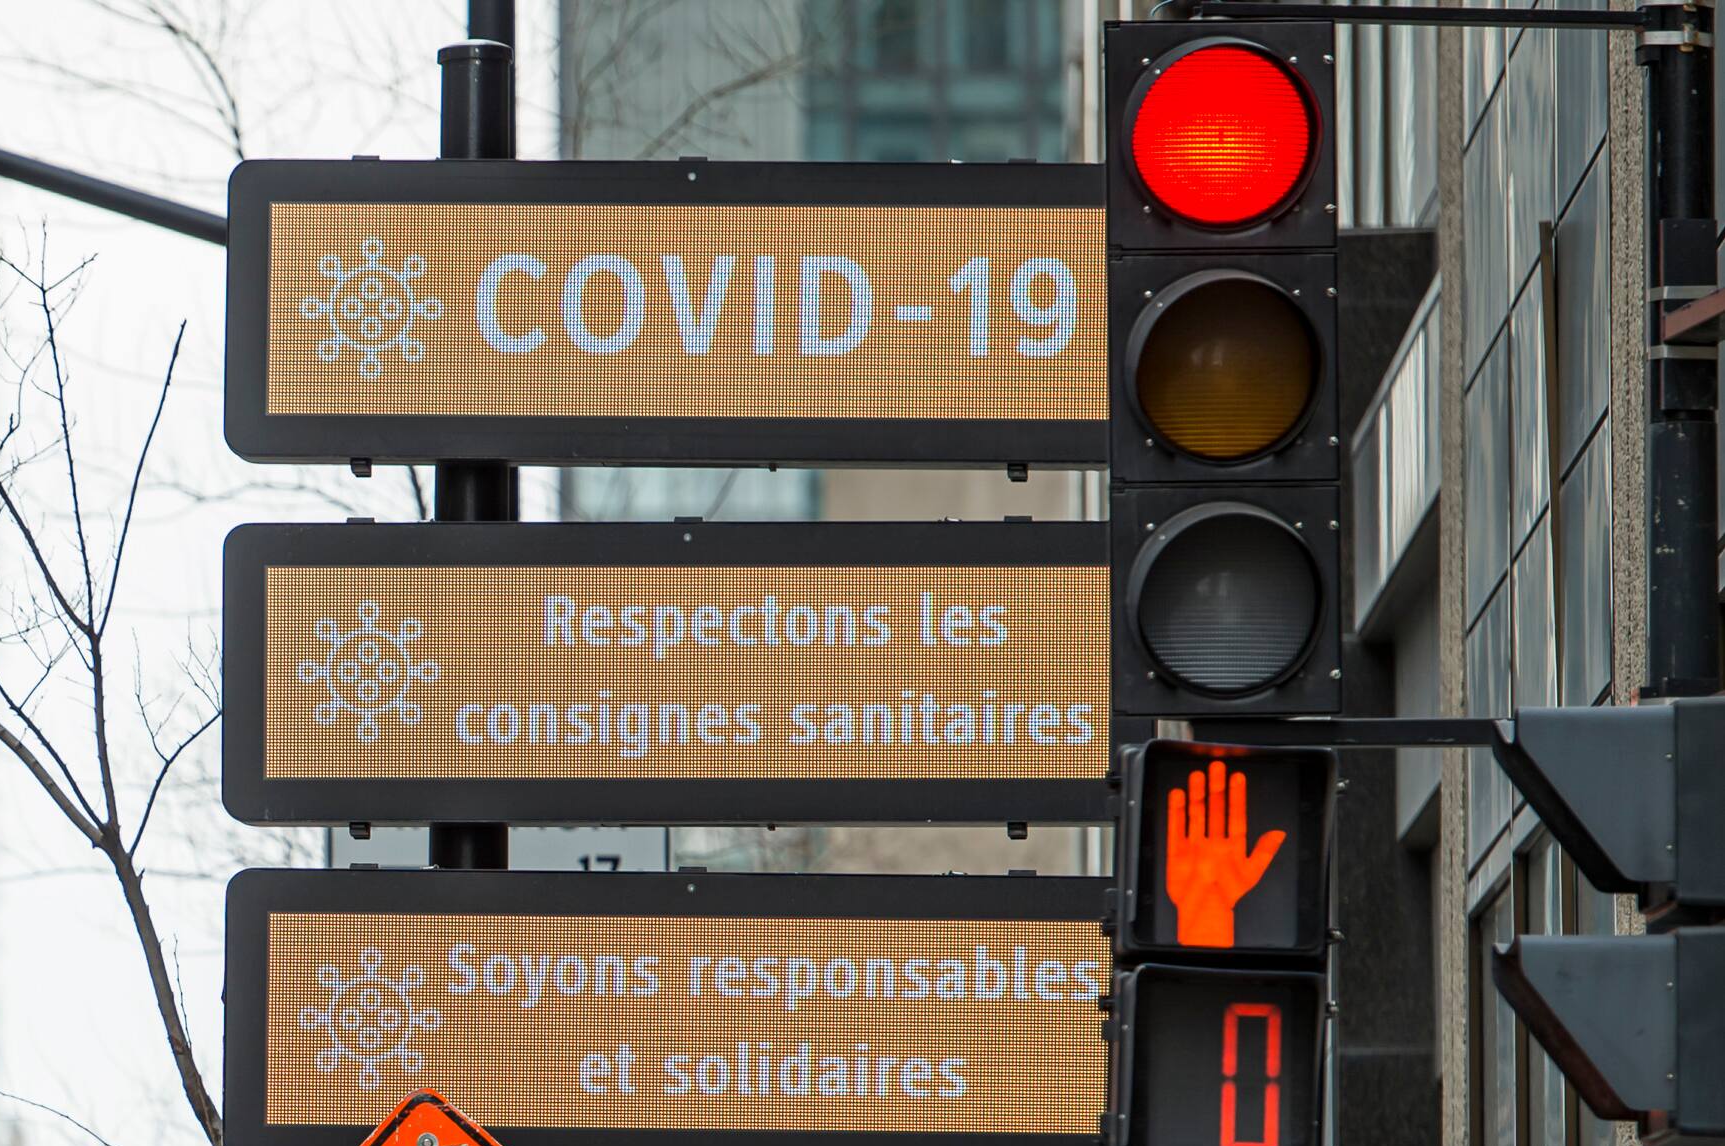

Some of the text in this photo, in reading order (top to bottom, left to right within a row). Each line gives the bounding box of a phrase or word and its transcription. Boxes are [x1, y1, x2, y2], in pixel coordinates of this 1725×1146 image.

[474, 253, 1078, 361] COVID-19
[542, 591, 1009, 660] Respectons les
[453, 689, 1095, 759] consignes sanitaires
[446, 941, 1102, 1012] Soyons responsables
[577, 1041, 971, 1099] et solidaires
